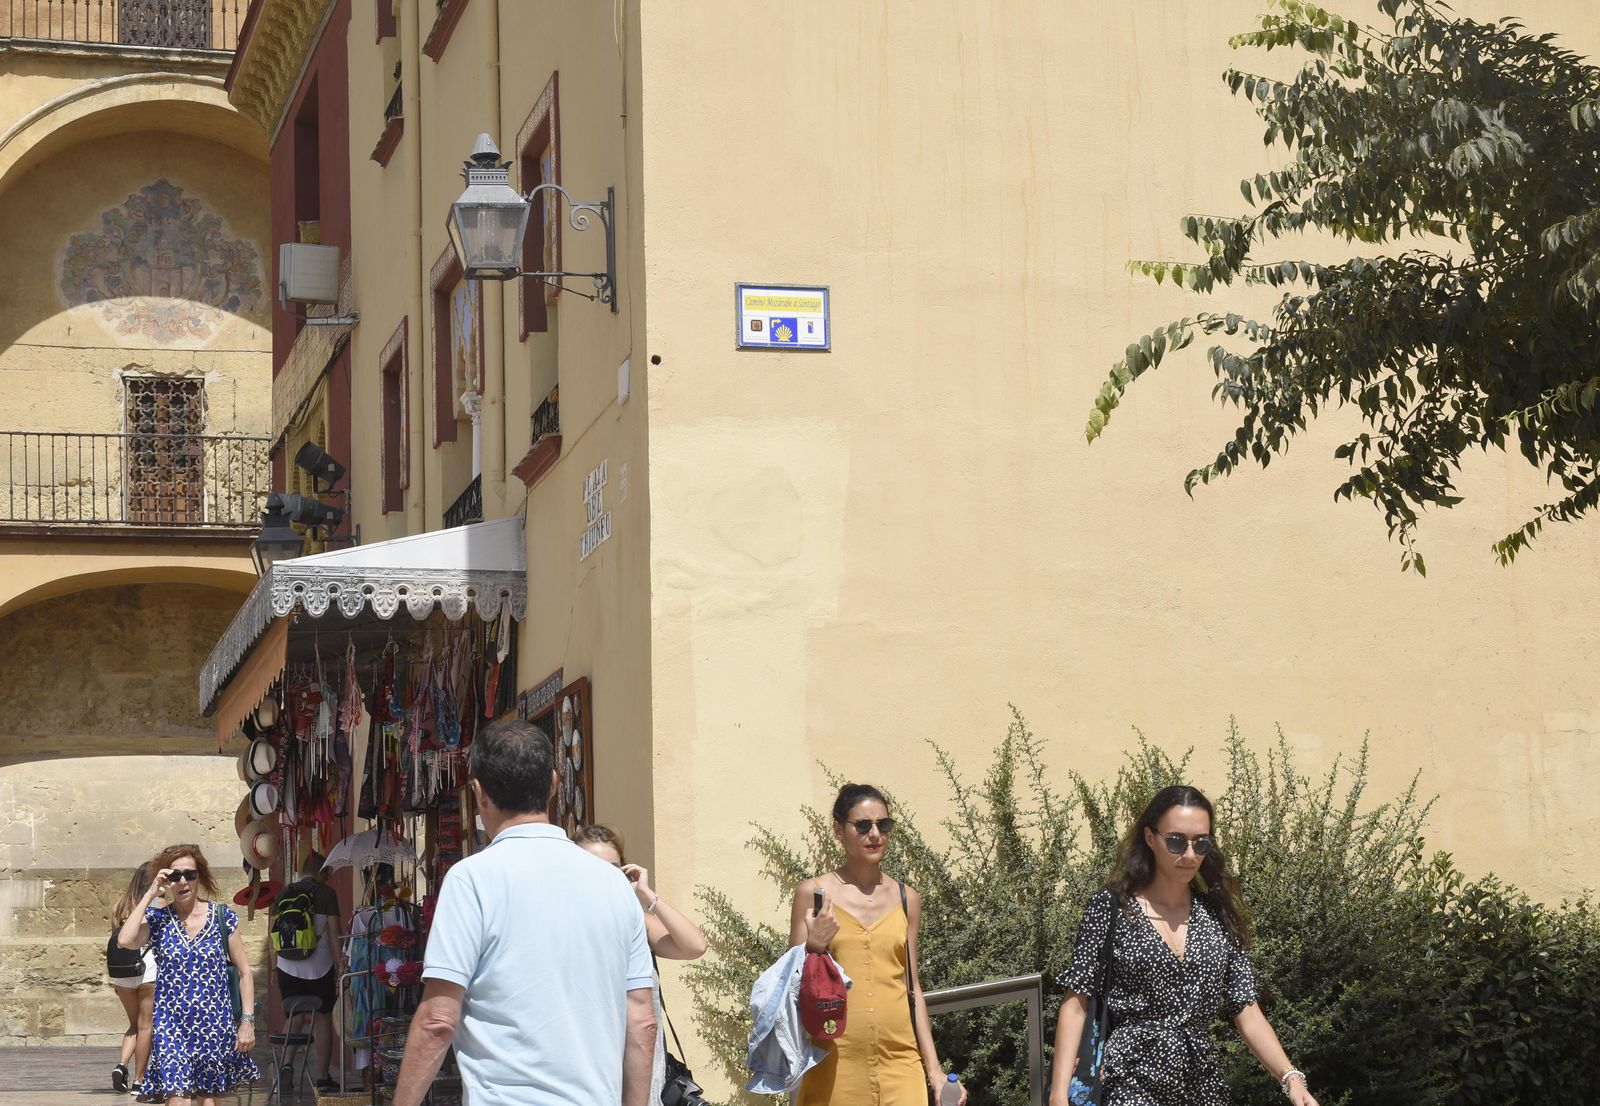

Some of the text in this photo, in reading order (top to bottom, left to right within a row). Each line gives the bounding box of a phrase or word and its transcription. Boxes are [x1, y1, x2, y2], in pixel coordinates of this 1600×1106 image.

[745, 297, 766, 307] Camino
[582, 460, 607, 502] PLAZA
[586, 492, 602, 523] DEL
[580, 513, 610, 559] TRIUNFO
